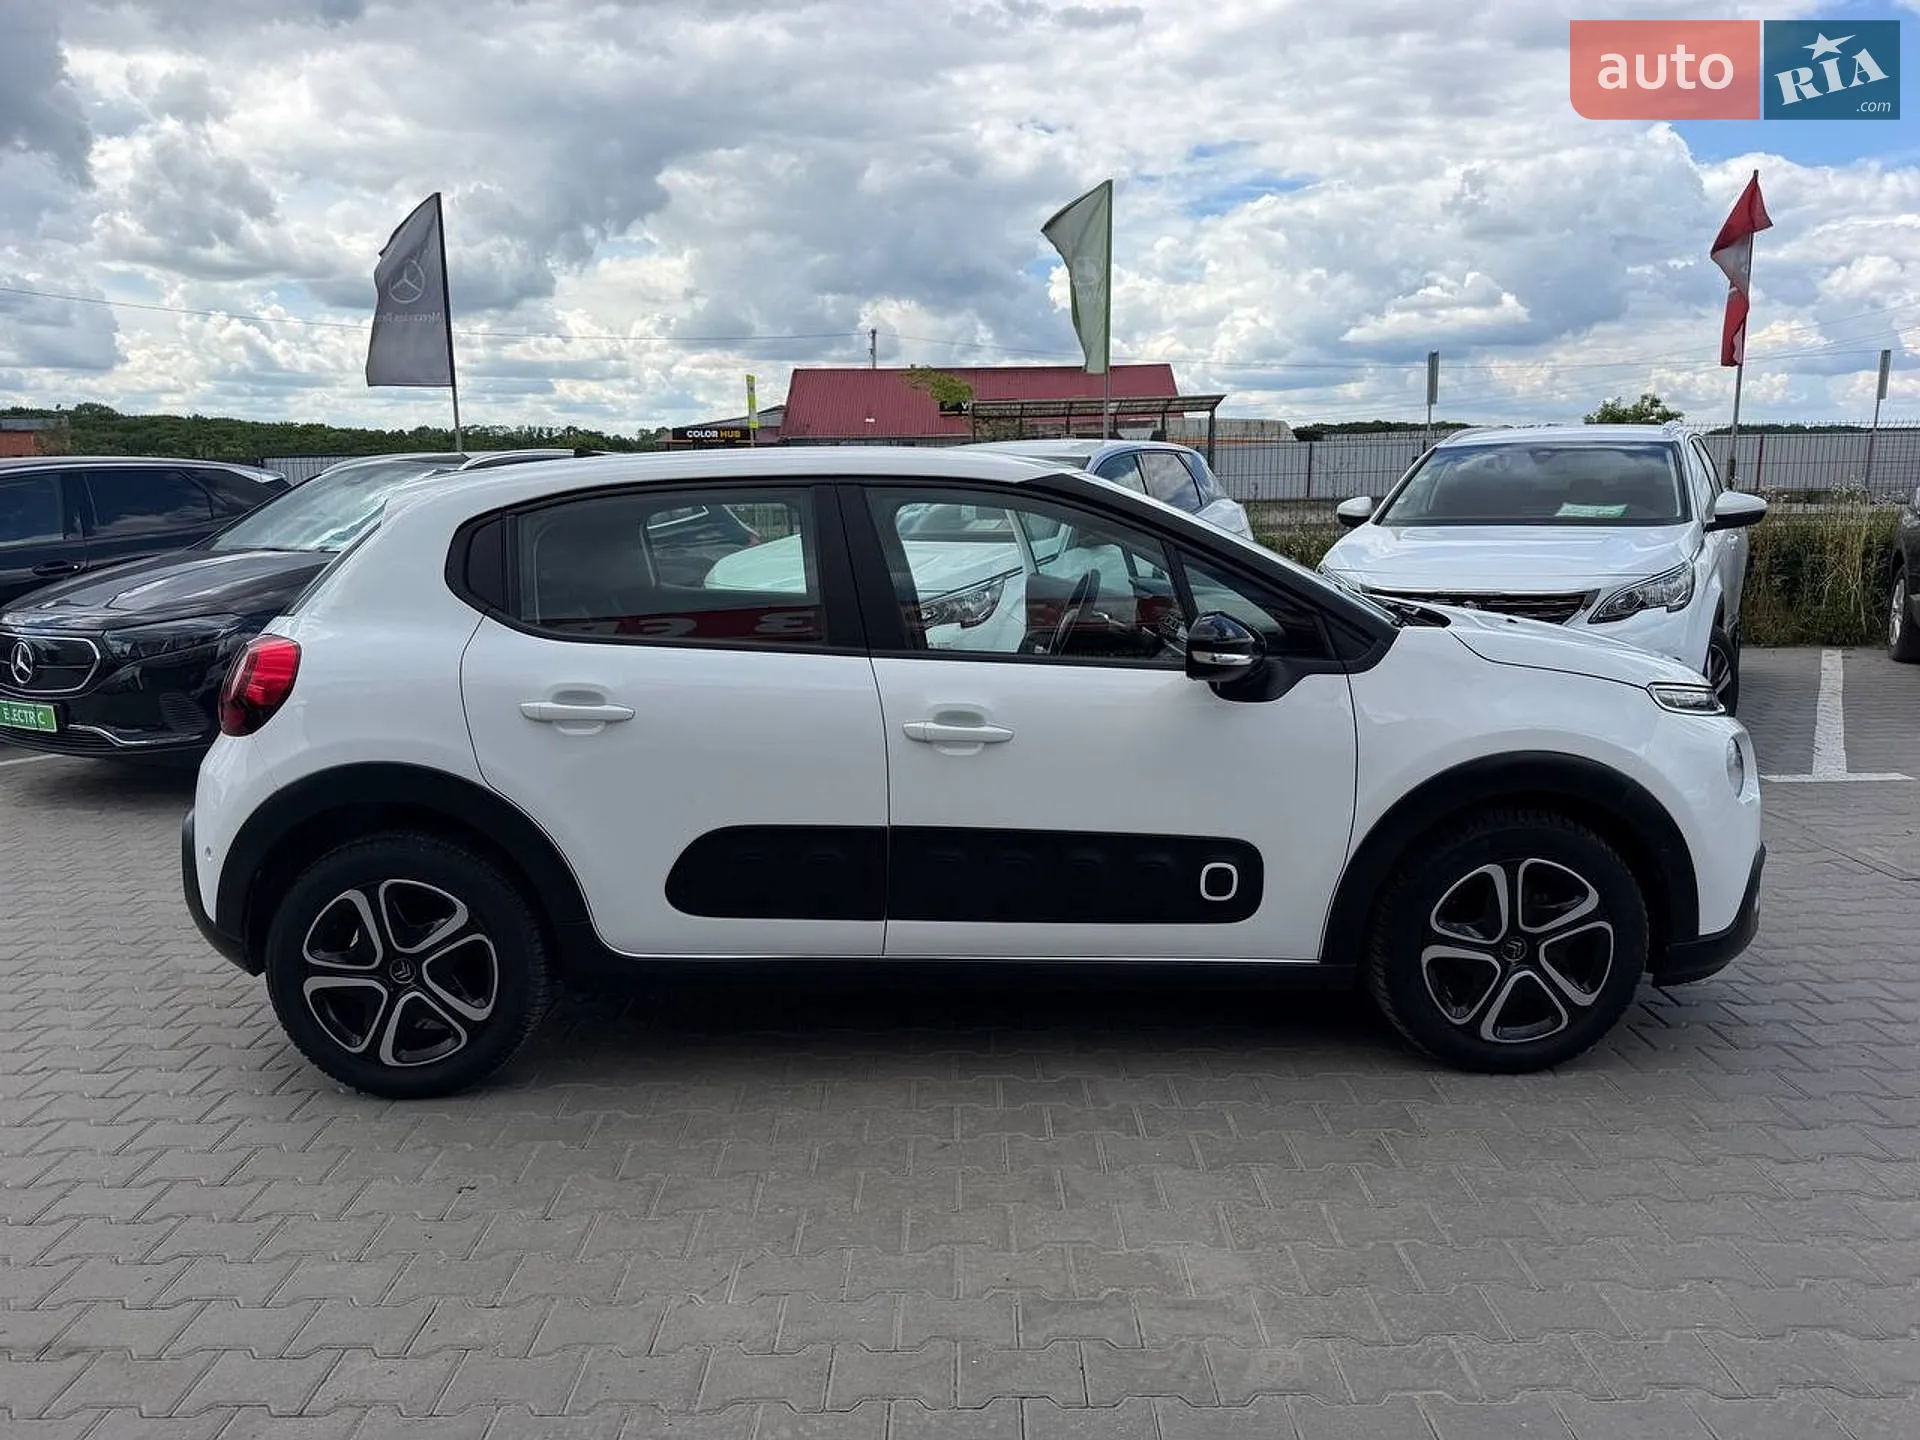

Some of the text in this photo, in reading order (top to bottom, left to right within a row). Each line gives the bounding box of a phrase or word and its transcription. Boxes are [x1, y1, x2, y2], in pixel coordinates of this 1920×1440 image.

[686, 430, 741, 438] COLOR HUB
[3, 707, 46, 725] EECTRC
